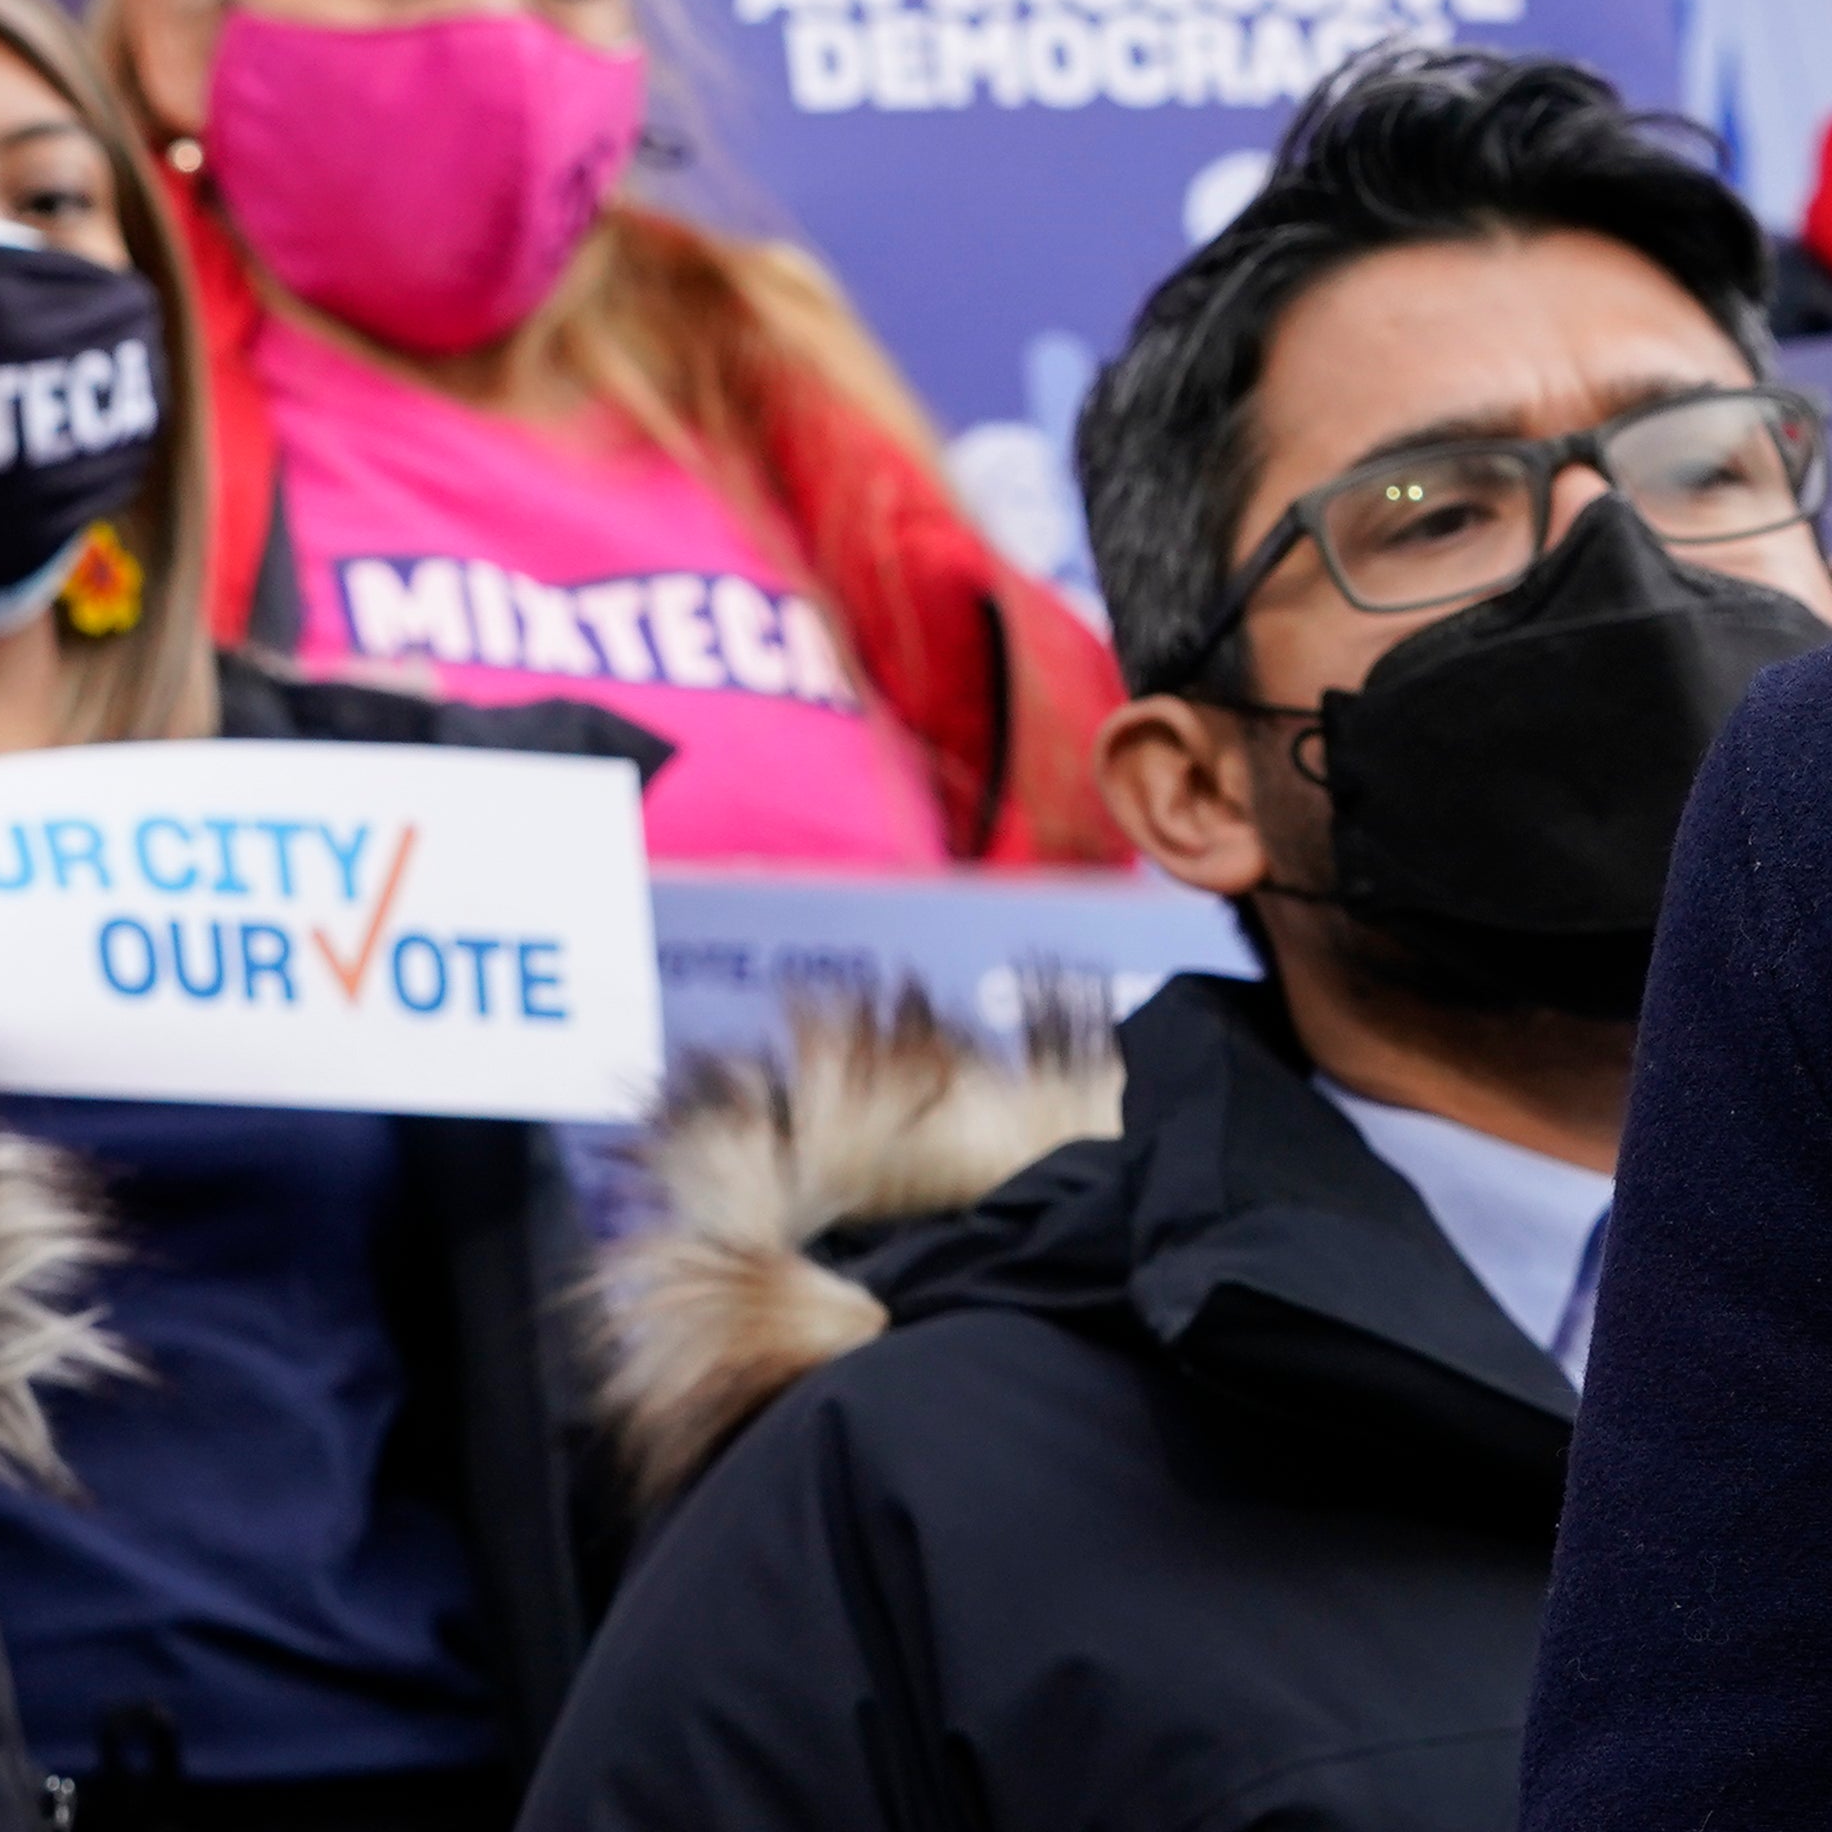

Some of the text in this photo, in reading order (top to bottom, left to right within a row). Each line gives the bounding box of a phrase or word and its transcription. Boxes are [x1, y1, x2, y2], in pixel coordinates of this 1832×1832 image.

[784, 6, 1453, 112] DEMOCRA
[134, 816, 374, 904] CITY
[97, 914, 297, 1005] OUR
